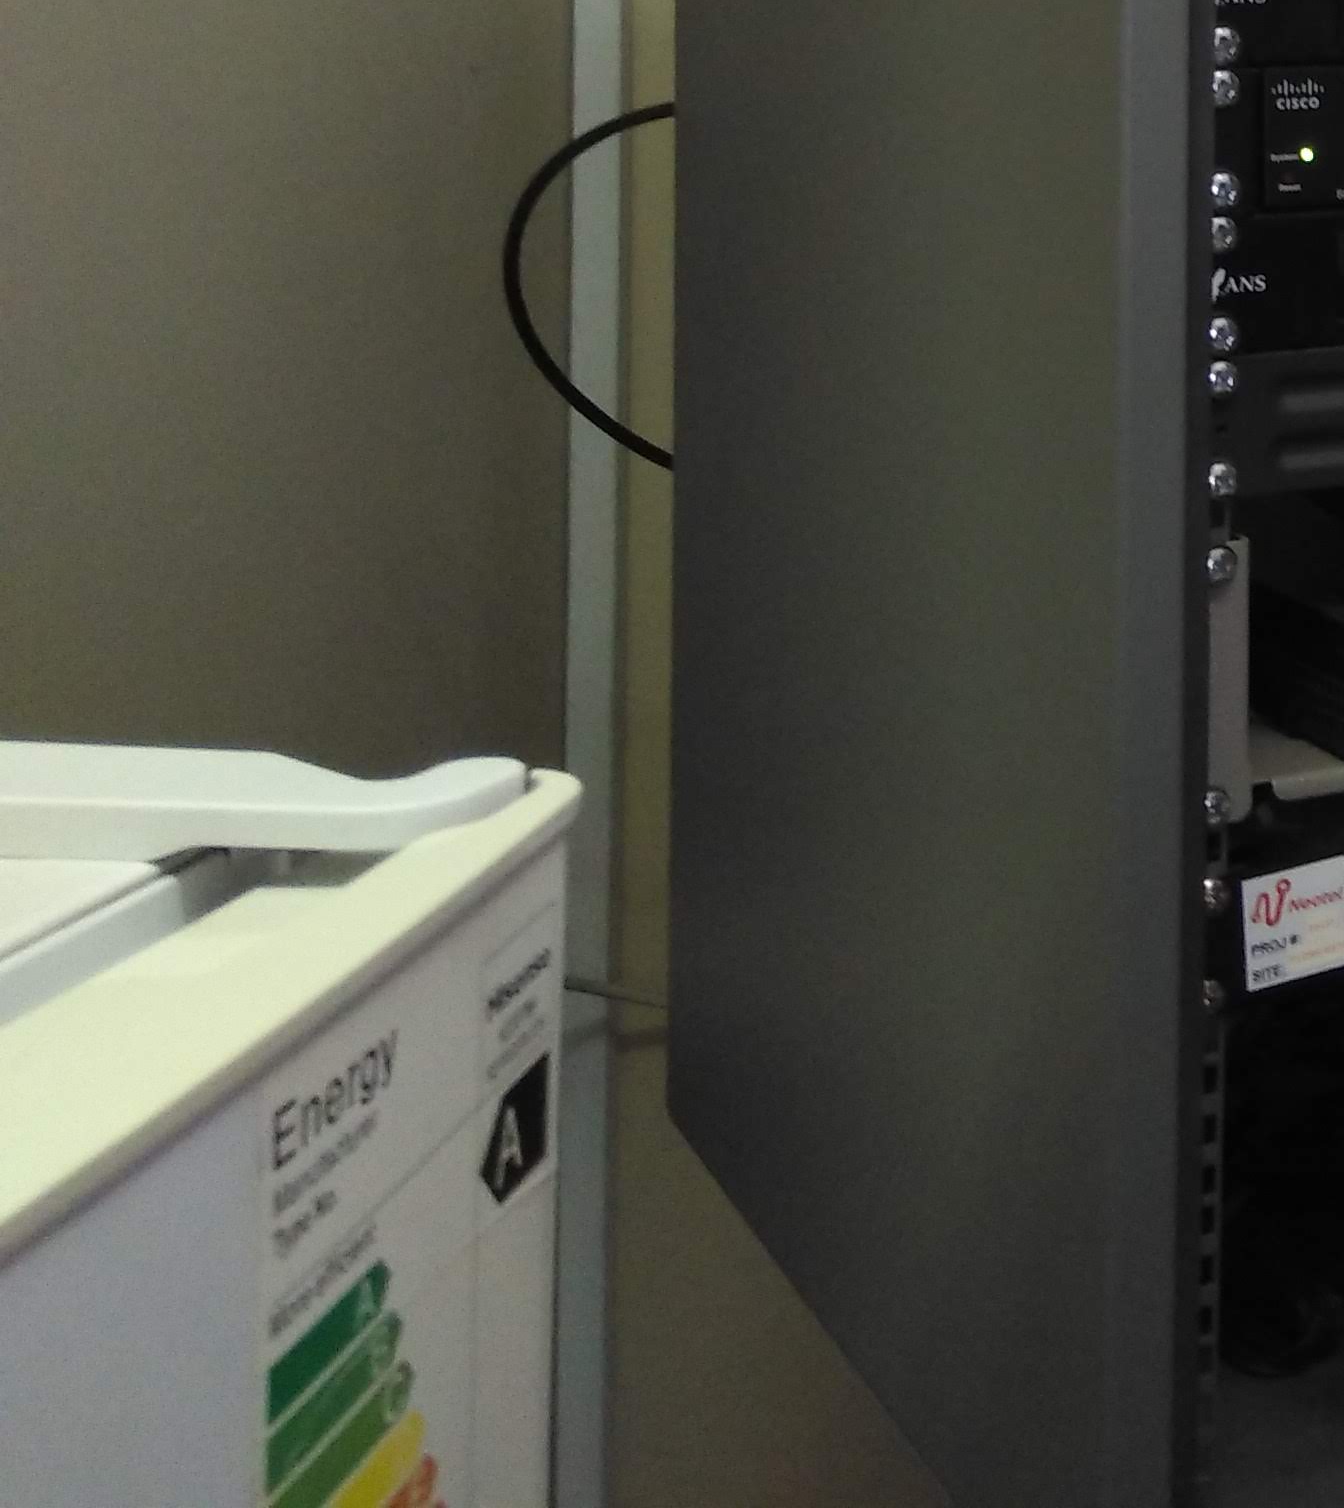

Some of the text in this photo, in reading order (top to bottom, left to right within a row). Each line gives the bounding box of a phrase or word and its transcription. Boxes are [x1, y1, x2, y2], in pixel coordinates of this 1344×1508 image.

[1275, 95, 1321, 111] cisco
[271, 1029, 399, 1172] Energy
[495, 1104, 522, 1188] A
